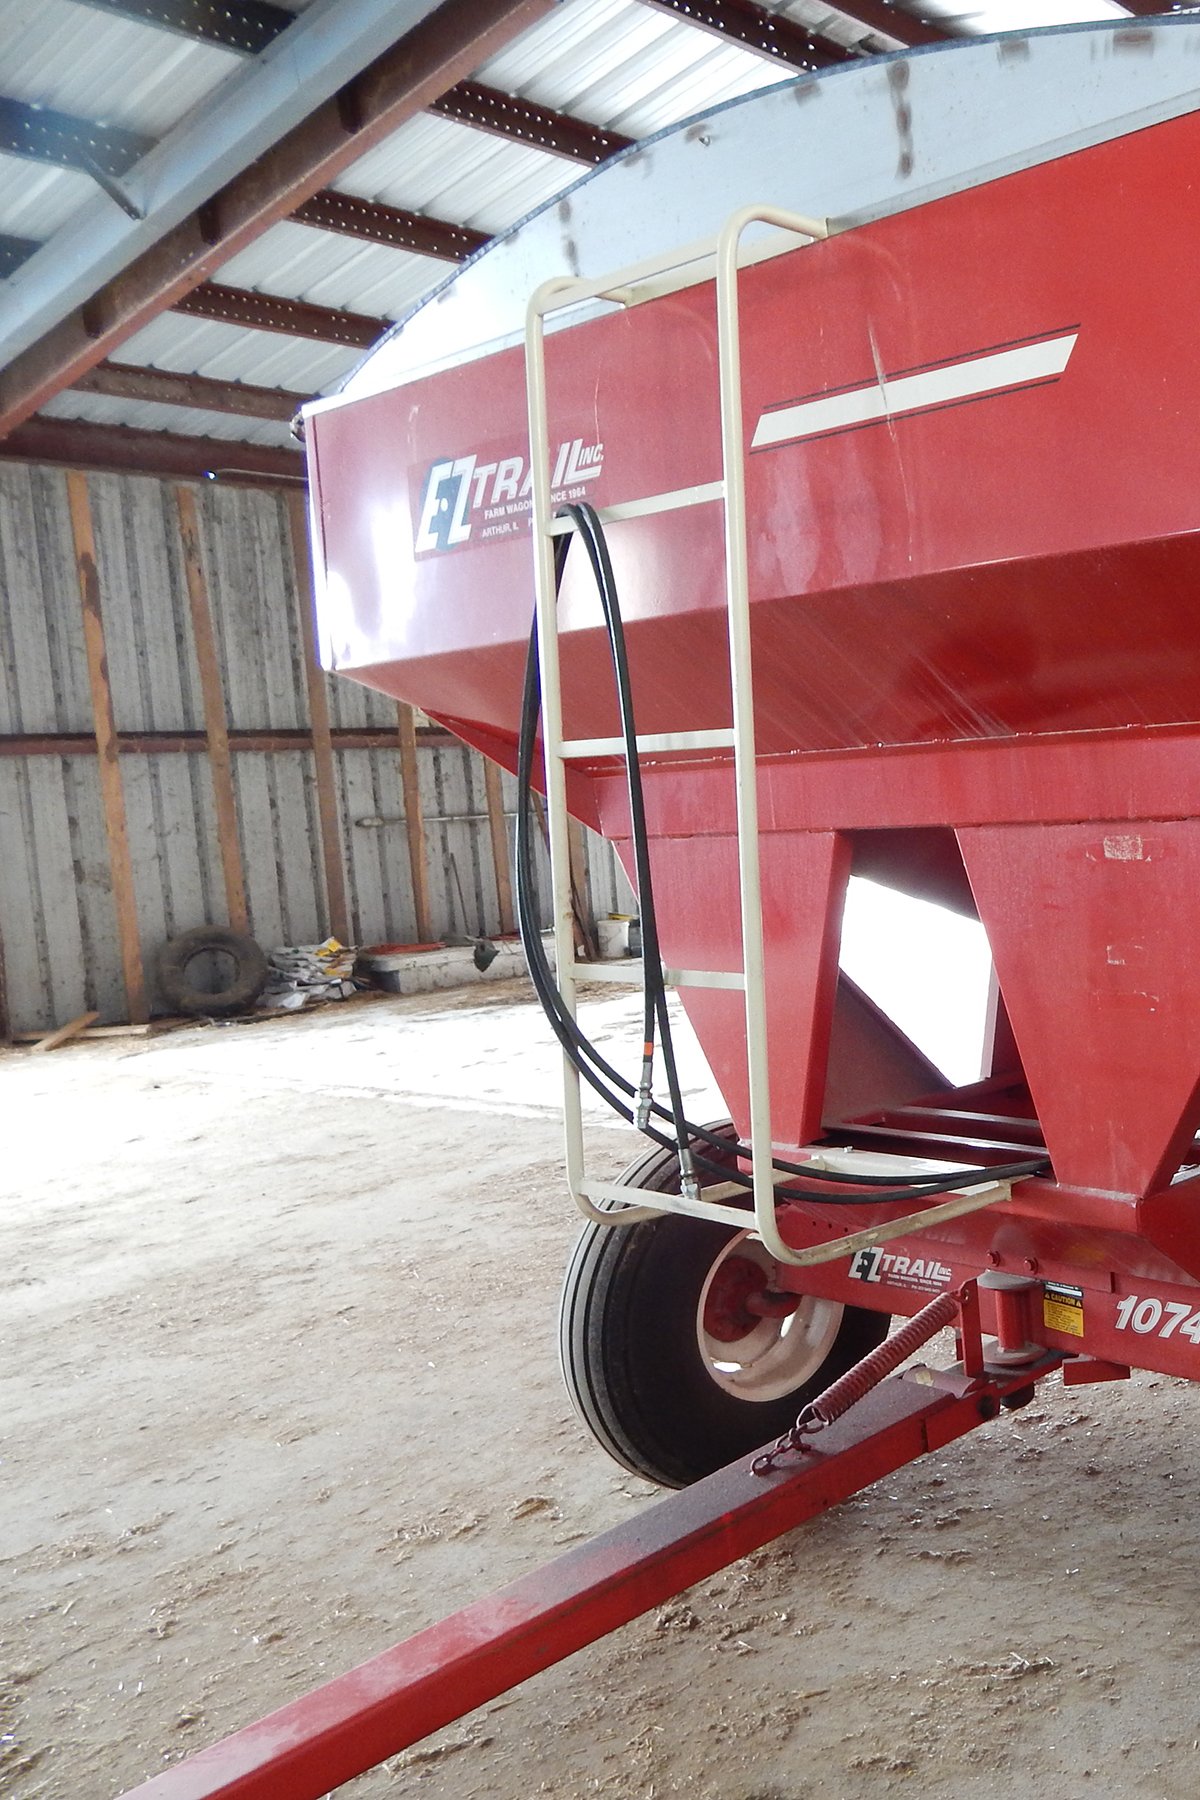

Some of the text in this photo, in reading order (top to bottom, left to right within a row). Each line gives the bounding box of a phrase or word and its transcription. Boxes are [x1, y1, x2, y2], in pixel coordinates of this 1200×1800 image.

[578, 442, 604, 467] INC.
[484, 508, 505, 520] FARM
[568, 486, 586, 498] 1964
[882, 1253, 951, 1282] TRAIL
